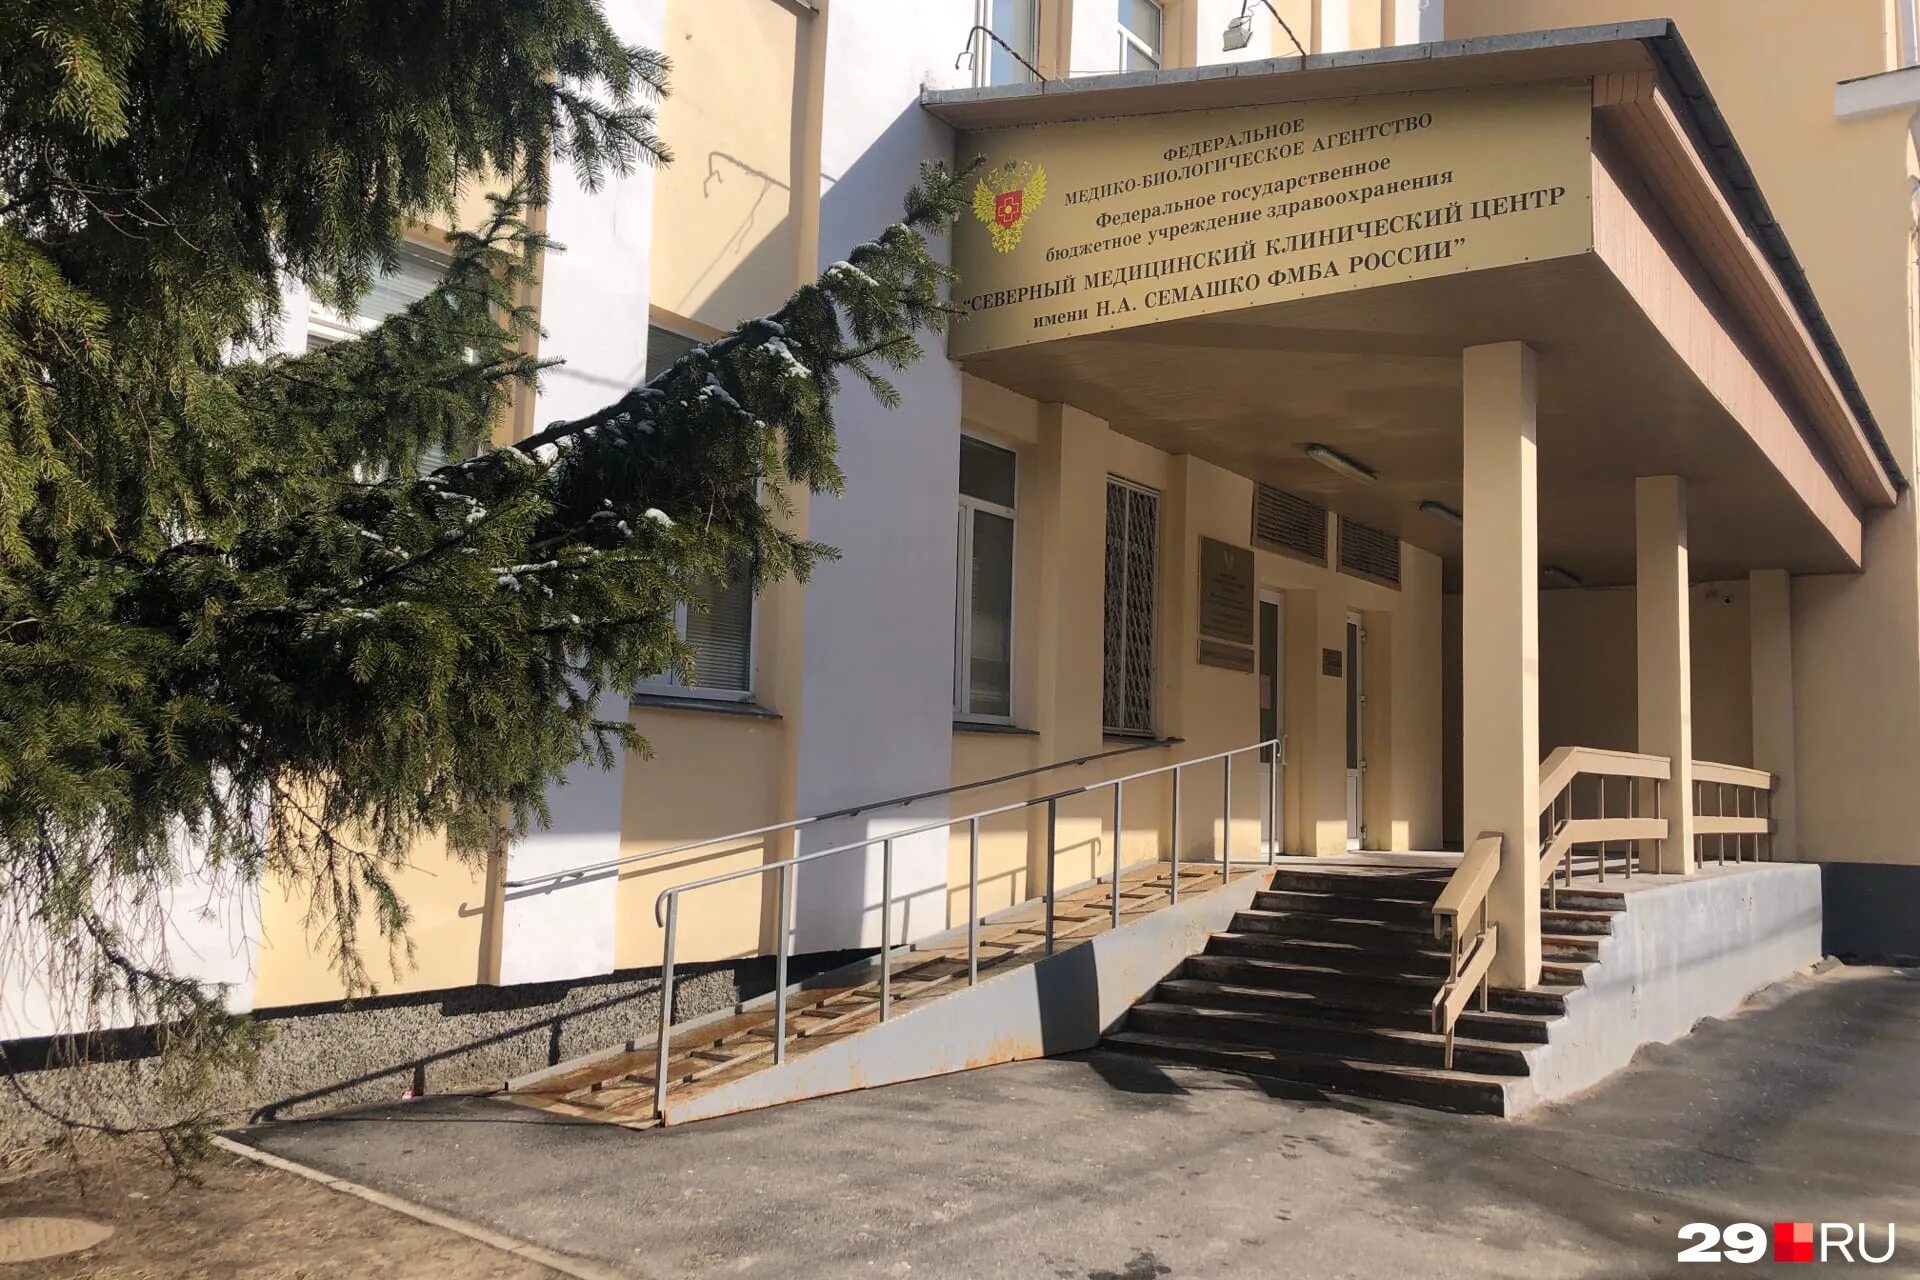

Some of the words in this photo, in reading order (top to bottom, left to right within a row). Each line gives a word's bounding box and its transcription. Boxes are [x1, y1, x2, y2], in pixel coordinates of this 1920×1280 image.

[1064, 141, 1305, 206] МЕДИКО-БИОЛОГИЧЕСКОЕ
[1312, 112, 1432, 152] АГЕНТСТВО
[1163, 118, 1305, 162] ФЕДЕРАЛЬНОЕ
[1046, 231, 1141, 263] бюджетное
[1148, 208, 1262, 246] учреждение
[1267, 169, 1454, 220] здравоохранения
[1096, 195, 1216, 228] Федеральное
[1222, 157, 1391, 203] государственное
[1084, 240, 1256, 290] МЕДИЦИНСКИЙ
[1265, 201, 1462, 257] КЛИНИЧЕСКИЙ
[1470, 186, 1566, 220] ЦЕНТР
[1033, 309, 1088, 329] имени
[1096, 297, 1137, 318] Н.А.
[1144, 273, 1260, 309] СЕМАШКО
[1267, 260, 1340, 288] ФМБА
